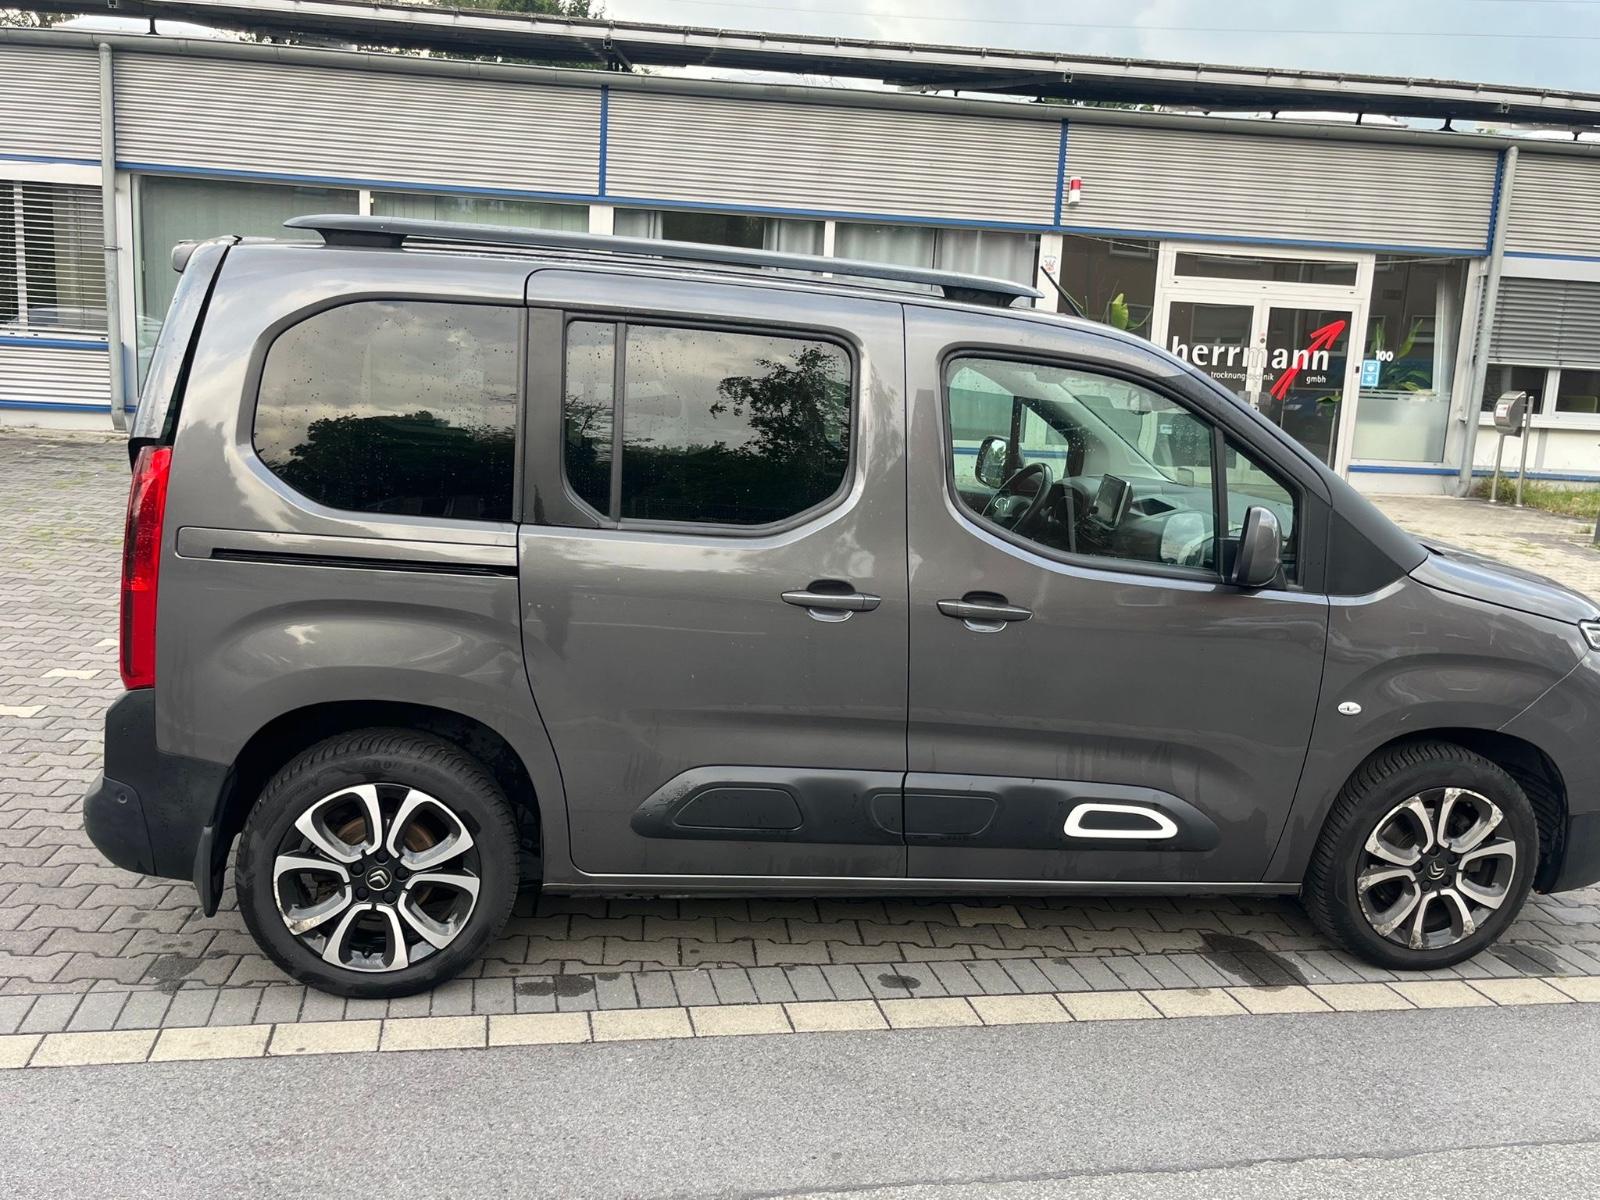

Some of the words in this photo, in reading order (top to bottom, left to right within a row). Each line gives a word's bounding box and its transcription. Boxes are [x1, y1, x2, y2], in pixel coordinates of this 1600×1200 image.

[1172, 336, 1329, 371] herrmann
[1375, 350, 1394, 362] 100
[1210, 371, 1274, 382] trocknungnik
[1306, 375, 1327, 385] gmbh
